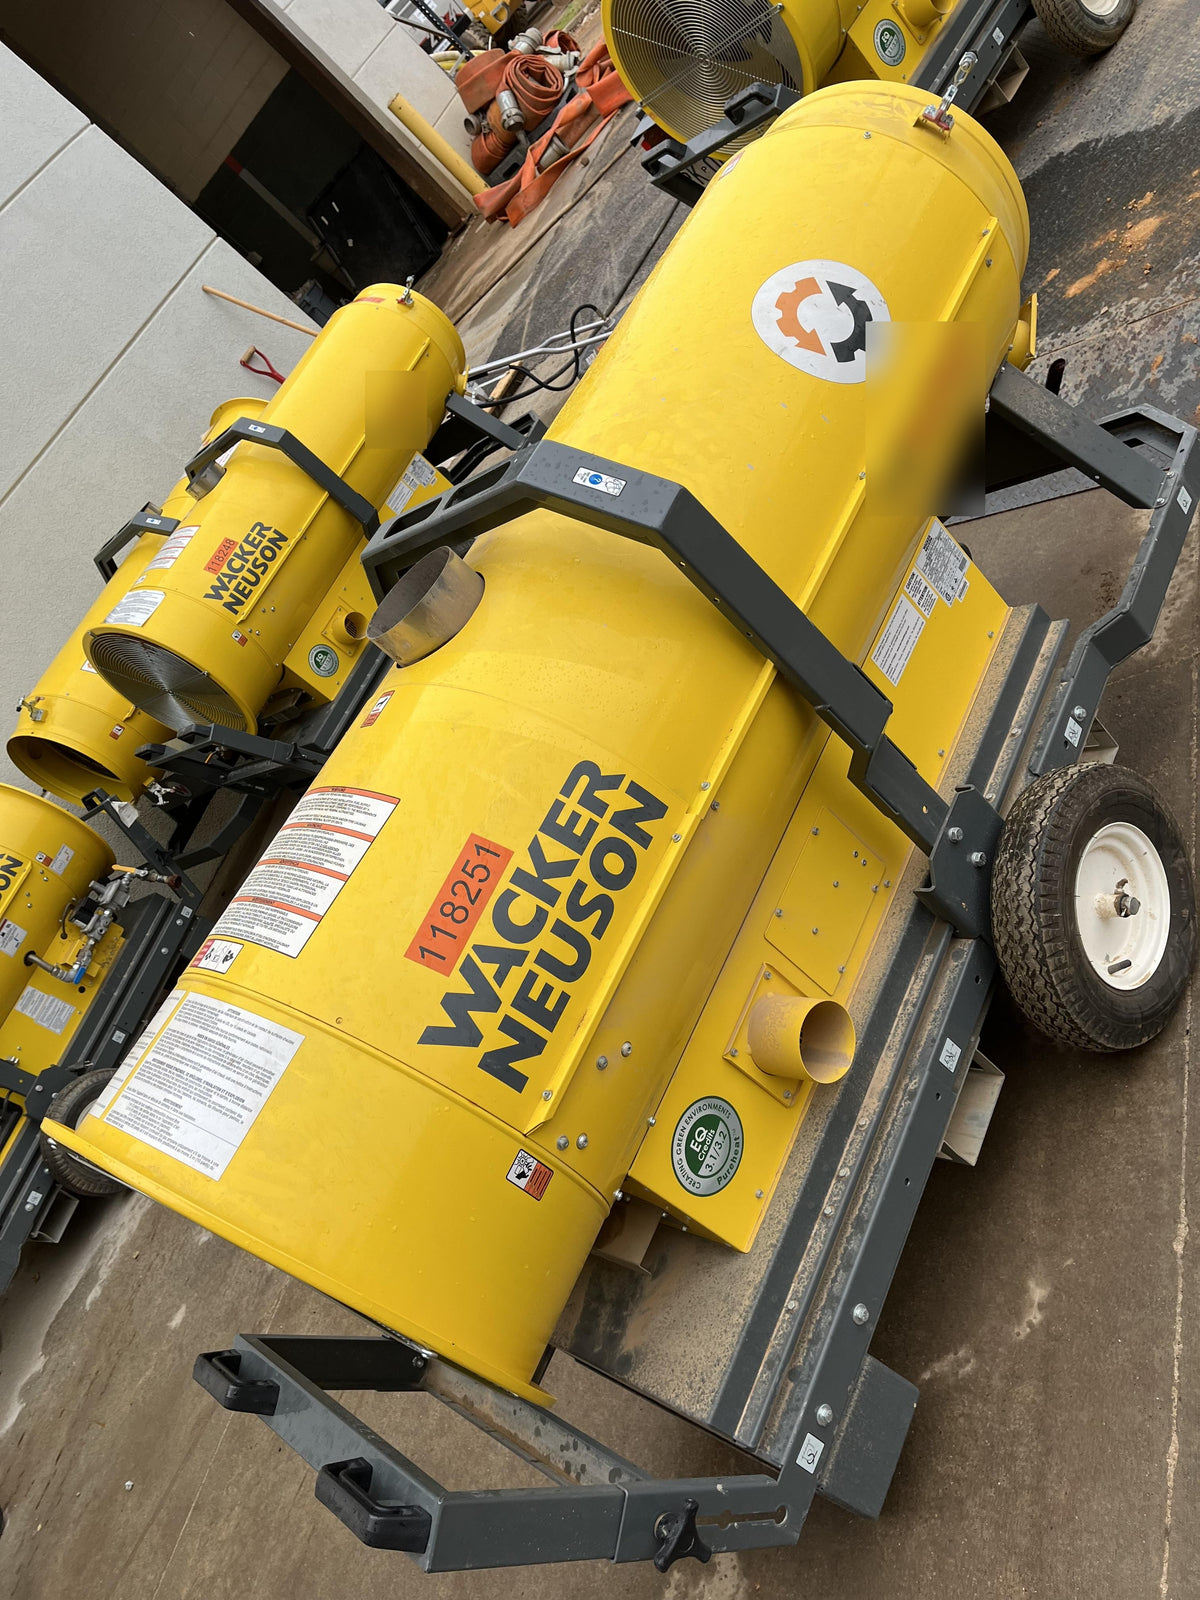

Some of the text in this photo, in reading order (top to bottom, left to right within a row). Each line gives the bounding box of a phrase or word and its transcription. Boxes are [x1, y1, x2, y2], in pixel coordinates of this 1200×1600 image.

[203, 522, 273, 601] WACKER
[207, 538, 235, 573] 118248
[222, 529, 289, 615] NEUSON
[417, 760, 626, 1047] WACKER
[419, 843, 501, 961] 118251
[477, 780, 669, 1094] NEUSON
[676, 1103, 732, 1189] CREATING GREEN ENVIRONMENTS
[689, 1126, 708, 1153] EQ
[698, 1129, 716, 1161] Credits
[705, 1130, 727, 1172] 3.1/3.2
[716, 1136, 740, 1185] Pureheat
